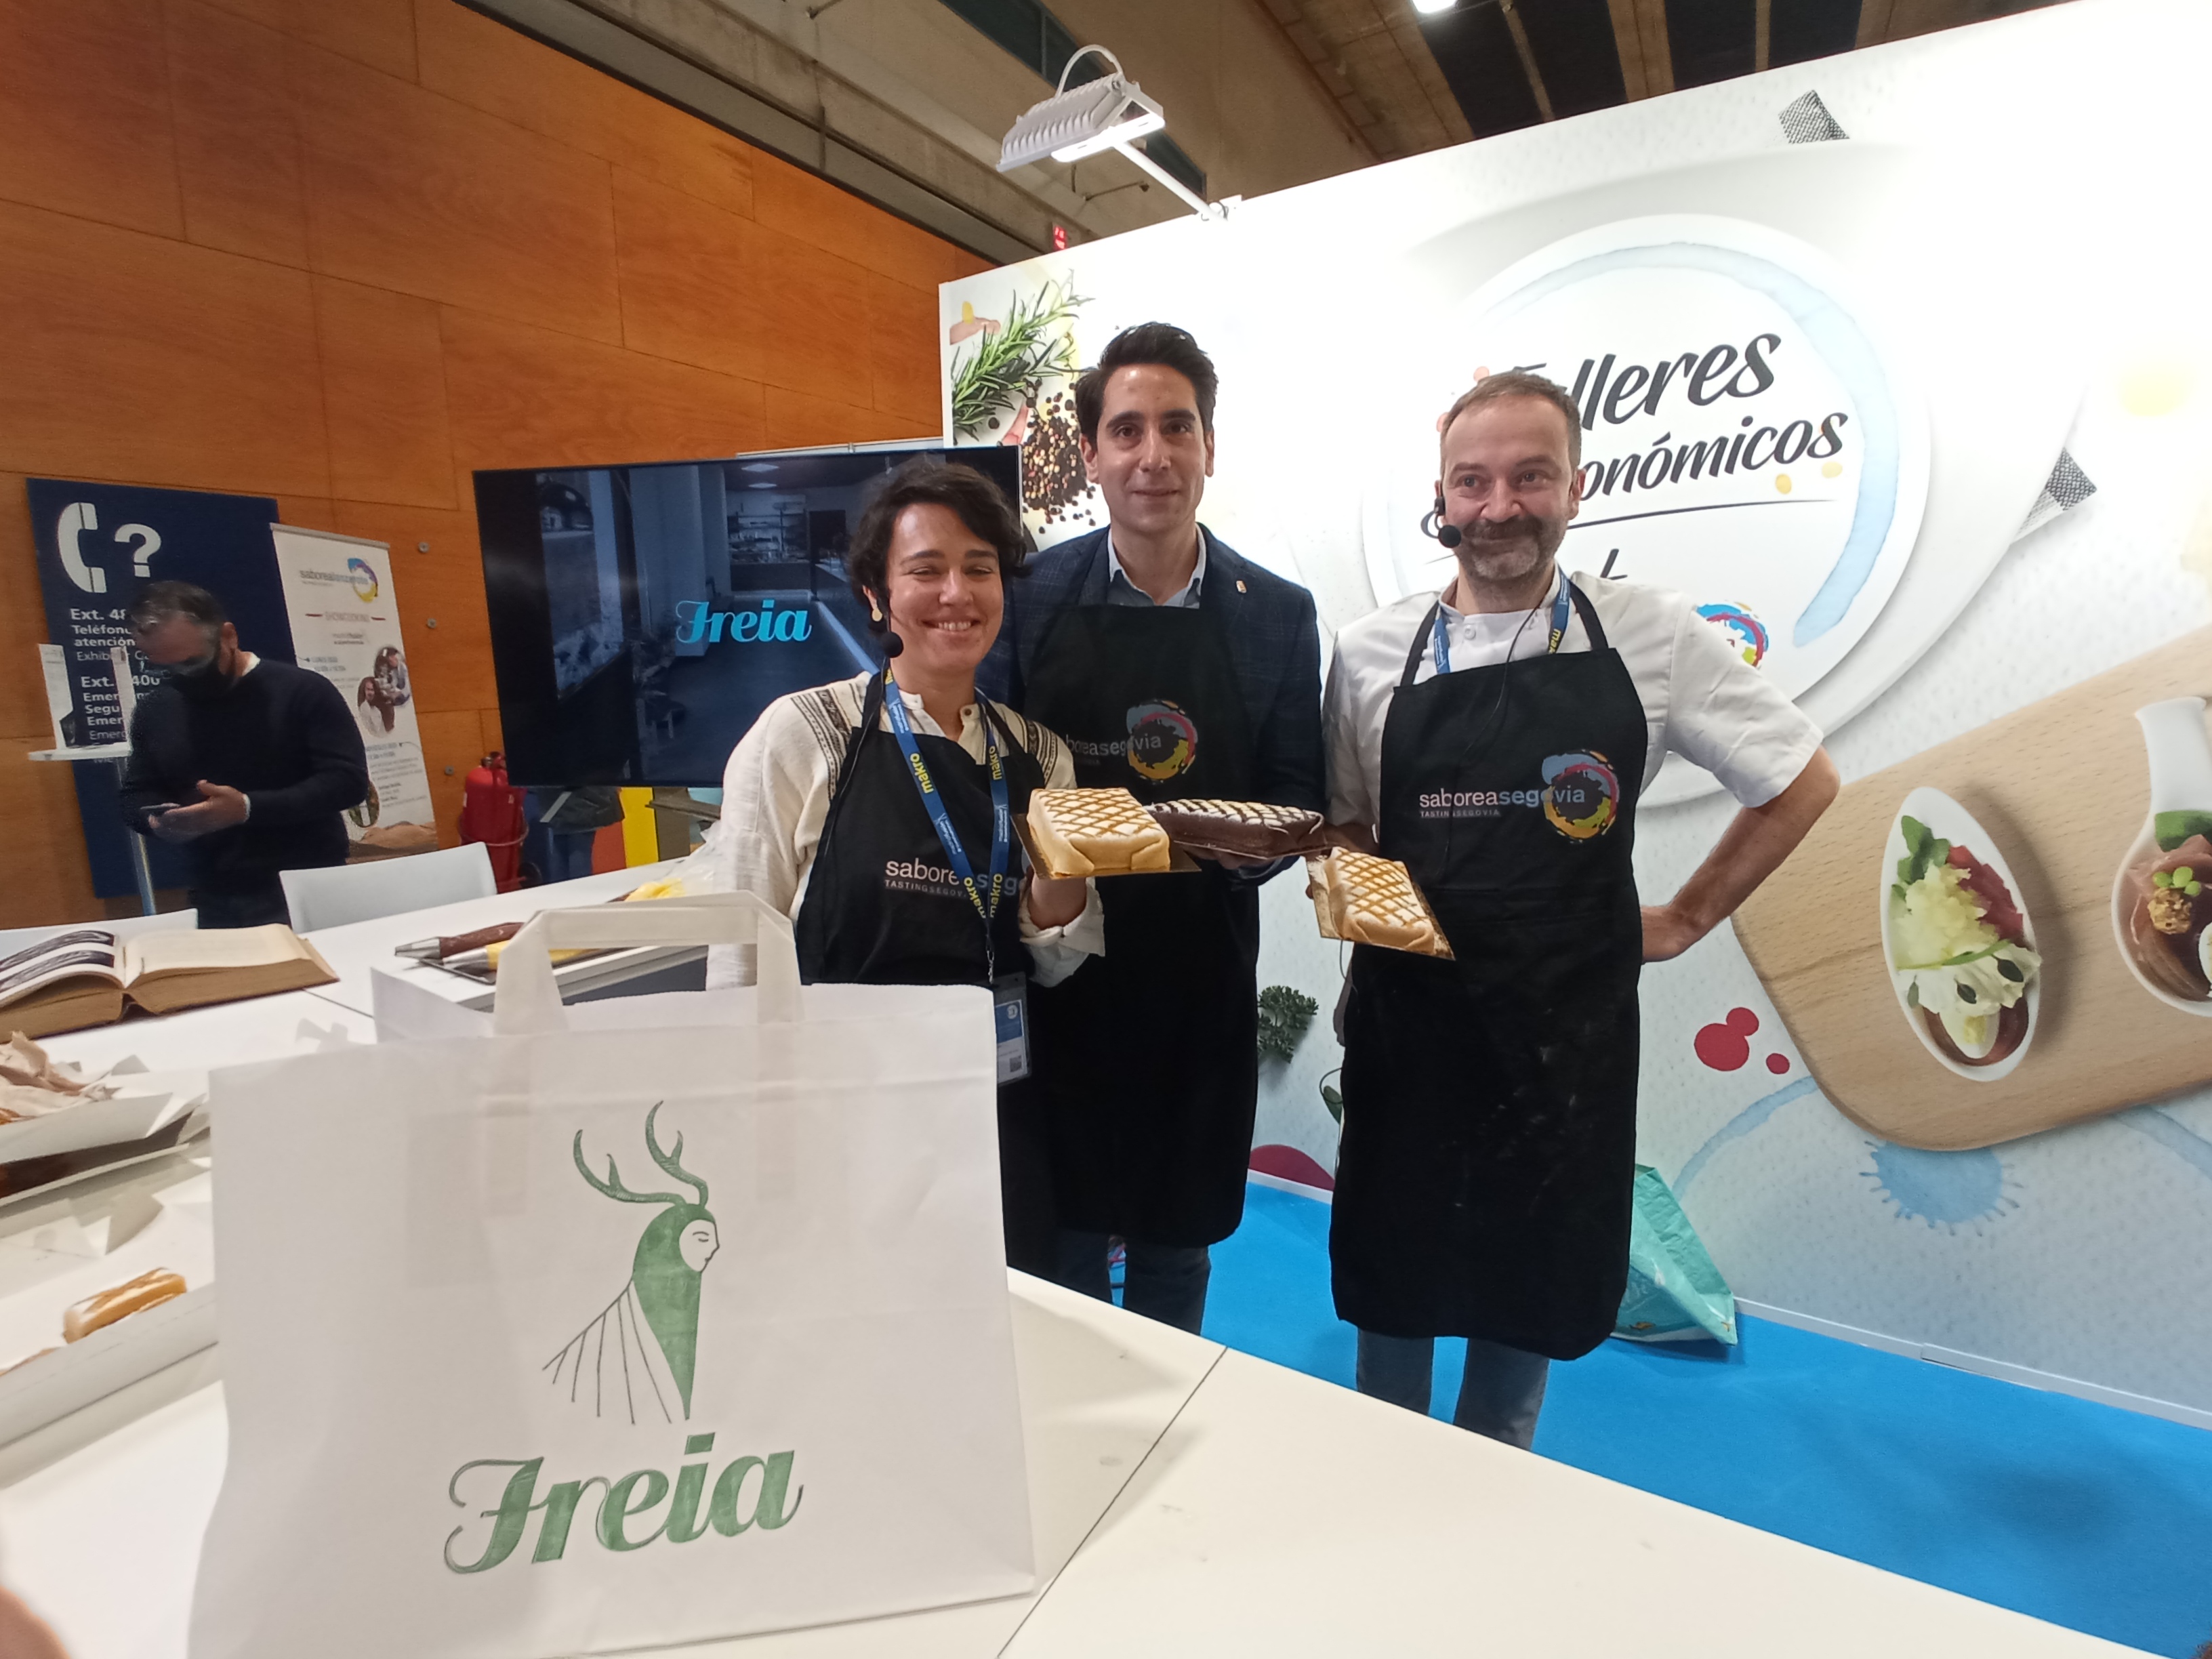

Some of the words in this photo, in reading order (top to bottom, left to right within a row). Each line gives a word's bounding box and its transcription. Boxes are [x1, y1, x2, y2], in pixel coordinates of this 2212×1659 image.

[1518, 333, 1782, 431] lleres
[70, 608, 104, 620] Ext.
[676, 599, 812, 643] Freia
[74, 636, 136, 647] atención
[81, 676, 114, 688] Ext.
[909, 753, 935, 794] makro
[989, 745, 1002, 781] makro
[964, 877, 987, 919] makro
[989, 874, 1003, 918] makro
[443, 1431, 804, 1576] Freia
